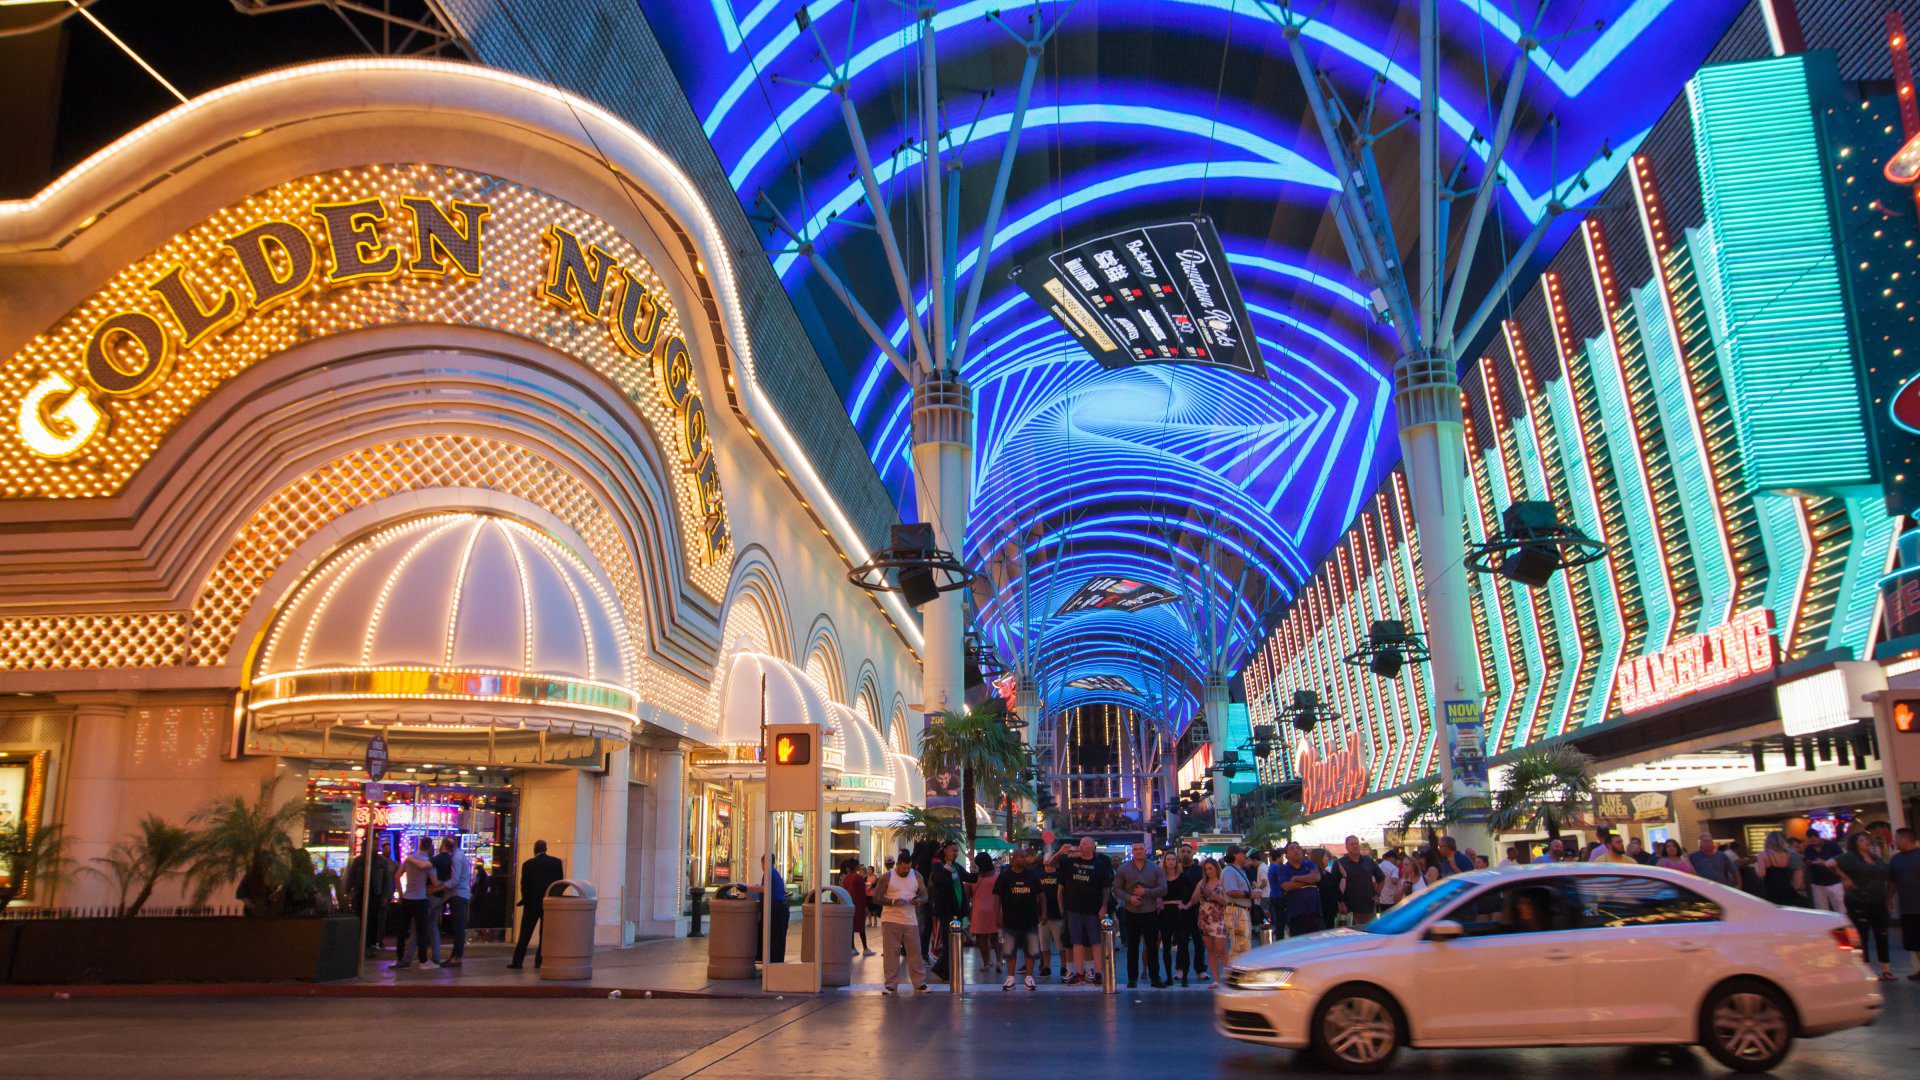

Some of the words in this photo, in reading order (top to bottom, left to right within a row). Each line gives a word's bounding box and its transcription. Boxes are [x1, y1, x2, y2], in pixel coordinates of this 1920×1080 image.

[1175, 249, 1213, 309] Downtown
[18, 195, 492, 461] GOLDEN
[539, 223, 727, 566] NUGGET
[1617, 605, 1773, 714] GAMBLING
[1448, 704, 1480, 717] NOW
[1601, 794, 1622, 806] LIVE
[1598, 805, 1628, 816] POKER
[1010, 886, 1031, 894] VIRGIN
